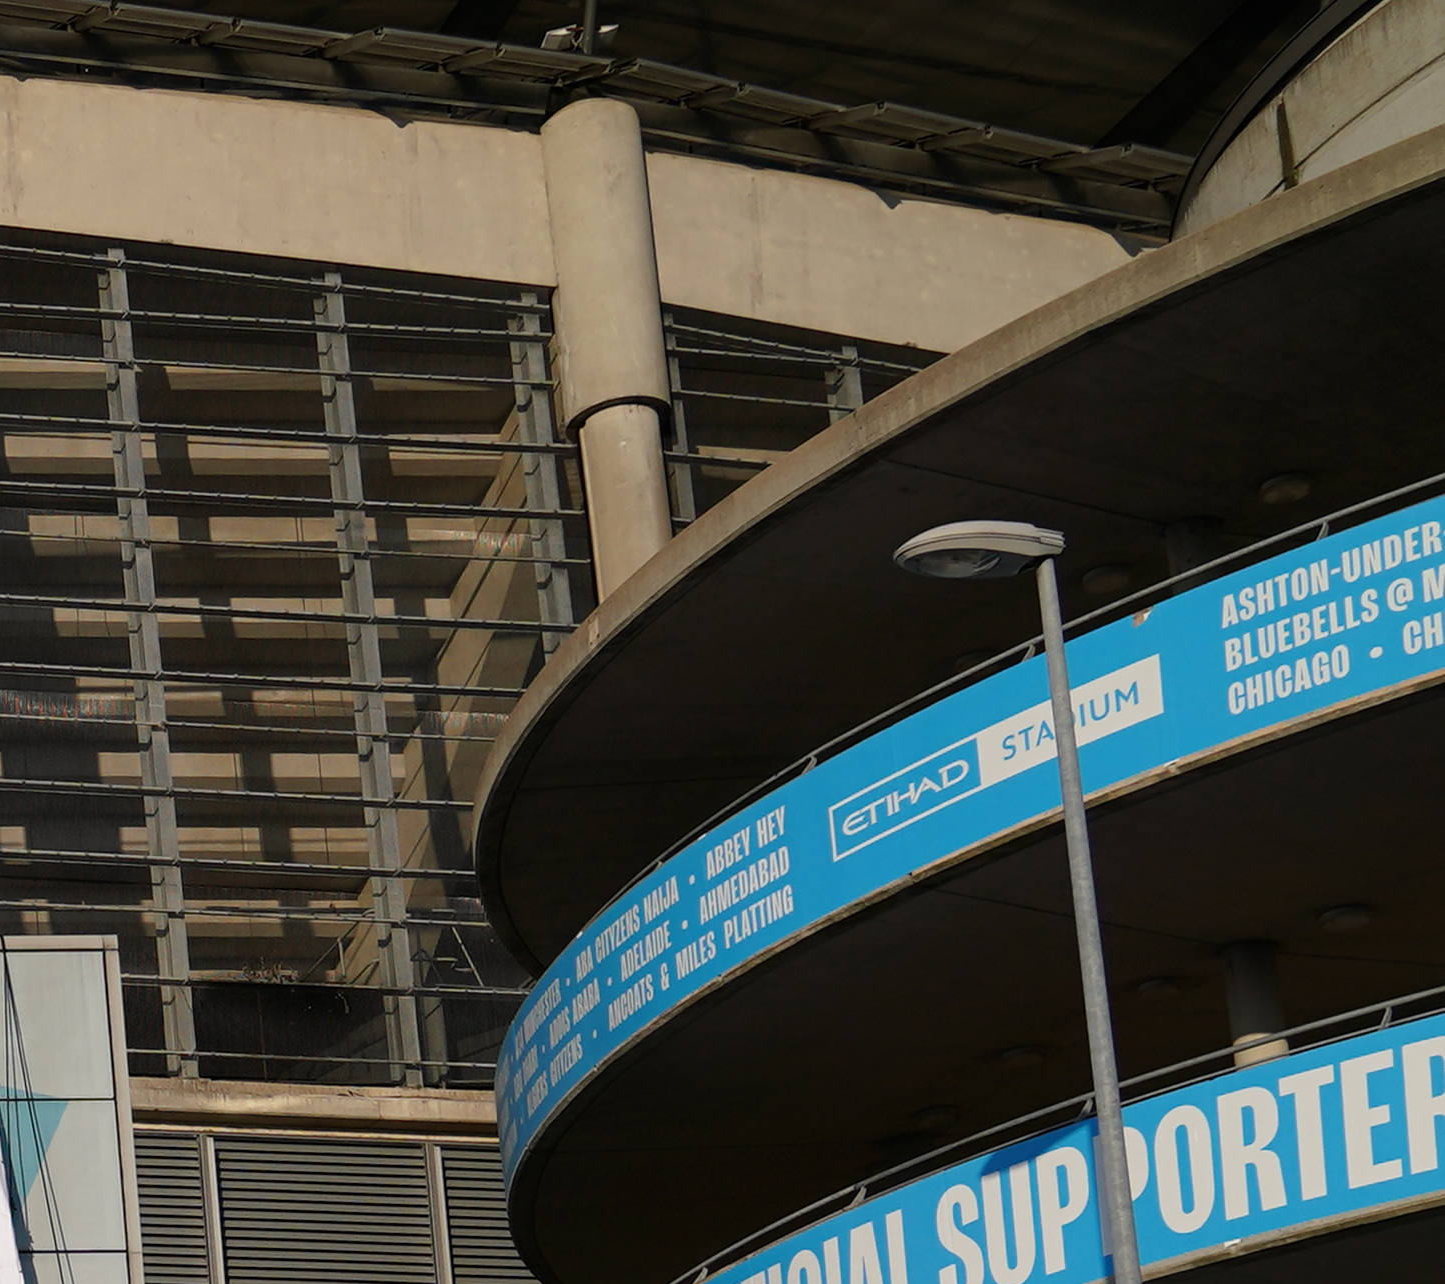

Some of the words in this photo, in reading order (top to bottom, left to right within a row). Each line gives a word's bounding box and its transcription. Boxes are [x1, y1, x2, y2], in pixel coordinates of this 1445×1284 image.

[1221, 520, 1445, 629] ASHTON-UNDER
[1224, 588, 1380, 673] BLUEBELLS
[1386, 577, 1414, 612] @
[1228, 644, 1350, 715] CHICAGO
[841, 759, 970, 837] ETIHAD
[1002, 681, 1140, 762] STAIUM
[594, 904, 641, 964] CITYZENS
[705, 826, 751, 881] ABBEY
[756, 805, 786, 848] HEY
[619, 920, 673, 982] ADELAIDE
[699, 846, 790, 925] AHMEDABAD
[607, 973, 654, 1032] ANCOATS
[675, 930, 717, 980] MILES
[723, 884, 795, 949] PLATTING
